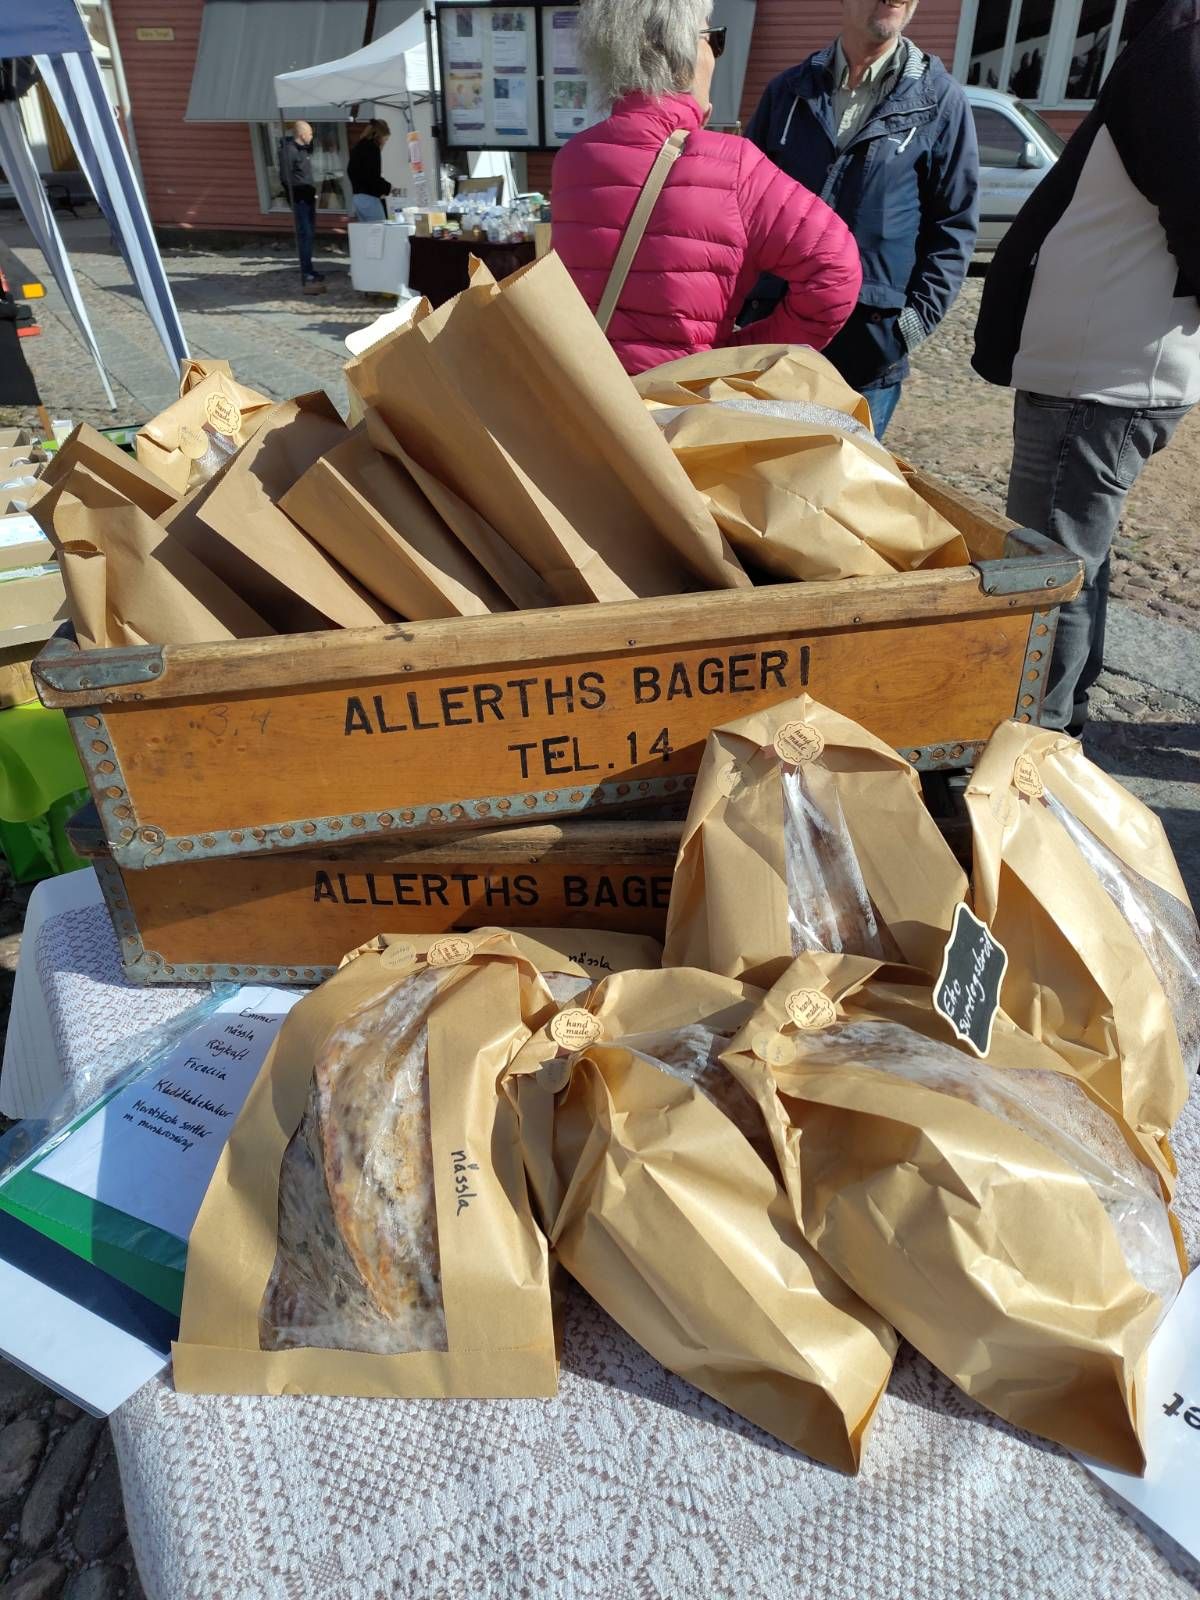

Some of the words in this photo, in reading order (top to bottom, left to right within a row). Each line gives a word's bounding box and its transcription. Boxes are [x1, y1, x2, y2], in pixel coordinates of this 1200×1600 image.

[344, 671, 606, 736] ALLERTHS
[633, 645, 810, 705] BAGERI
[314, 870, 539, 907] ALLERTHS
[943, 978, 962, 1017] Eko
[451, 1150, 480, 1216] nässla
